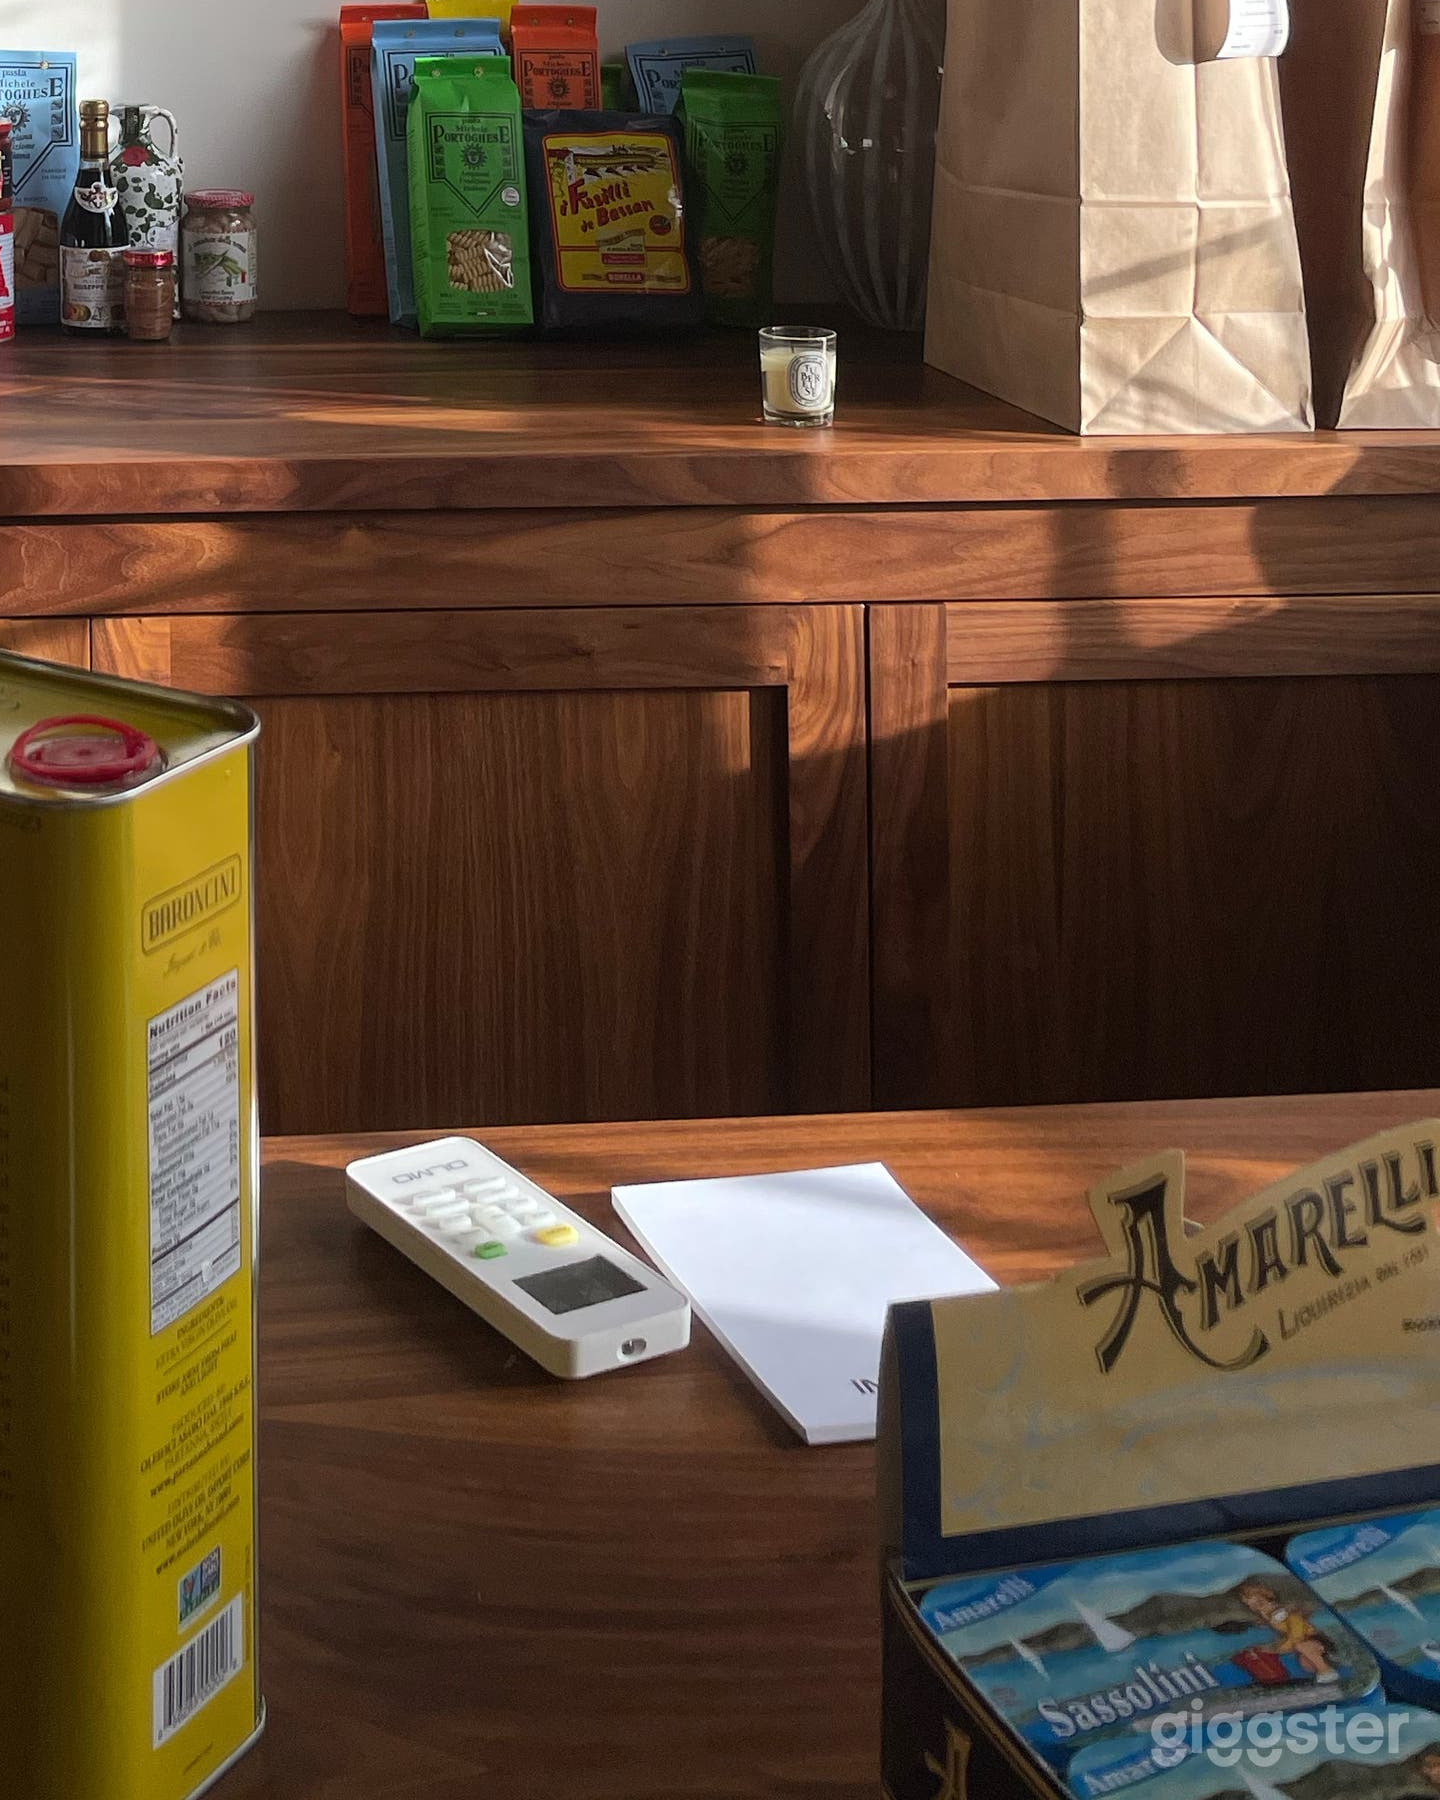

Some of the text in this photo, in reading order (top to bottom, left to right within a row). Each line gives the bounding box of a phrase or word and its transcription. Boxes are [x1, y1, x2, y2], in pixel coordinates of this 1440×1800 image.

[2, 68, 27, 79] pasta
[523, 60, 591, 77] PORTOGHESE
[433, 125, 510, 144] PORTOGHESE
[148, 865, 235, 941] BARONCINI
[149, 973, 236, 1042] Nutrition Facts
[1076, 1138, 1440, 1375] AMARELLI
[1298, 1524, 1392, 1578] Amarelli
[932, 1574, 1036, 1633] Amarelli
[1037, 1651, 1221, 1740] Sassolini
